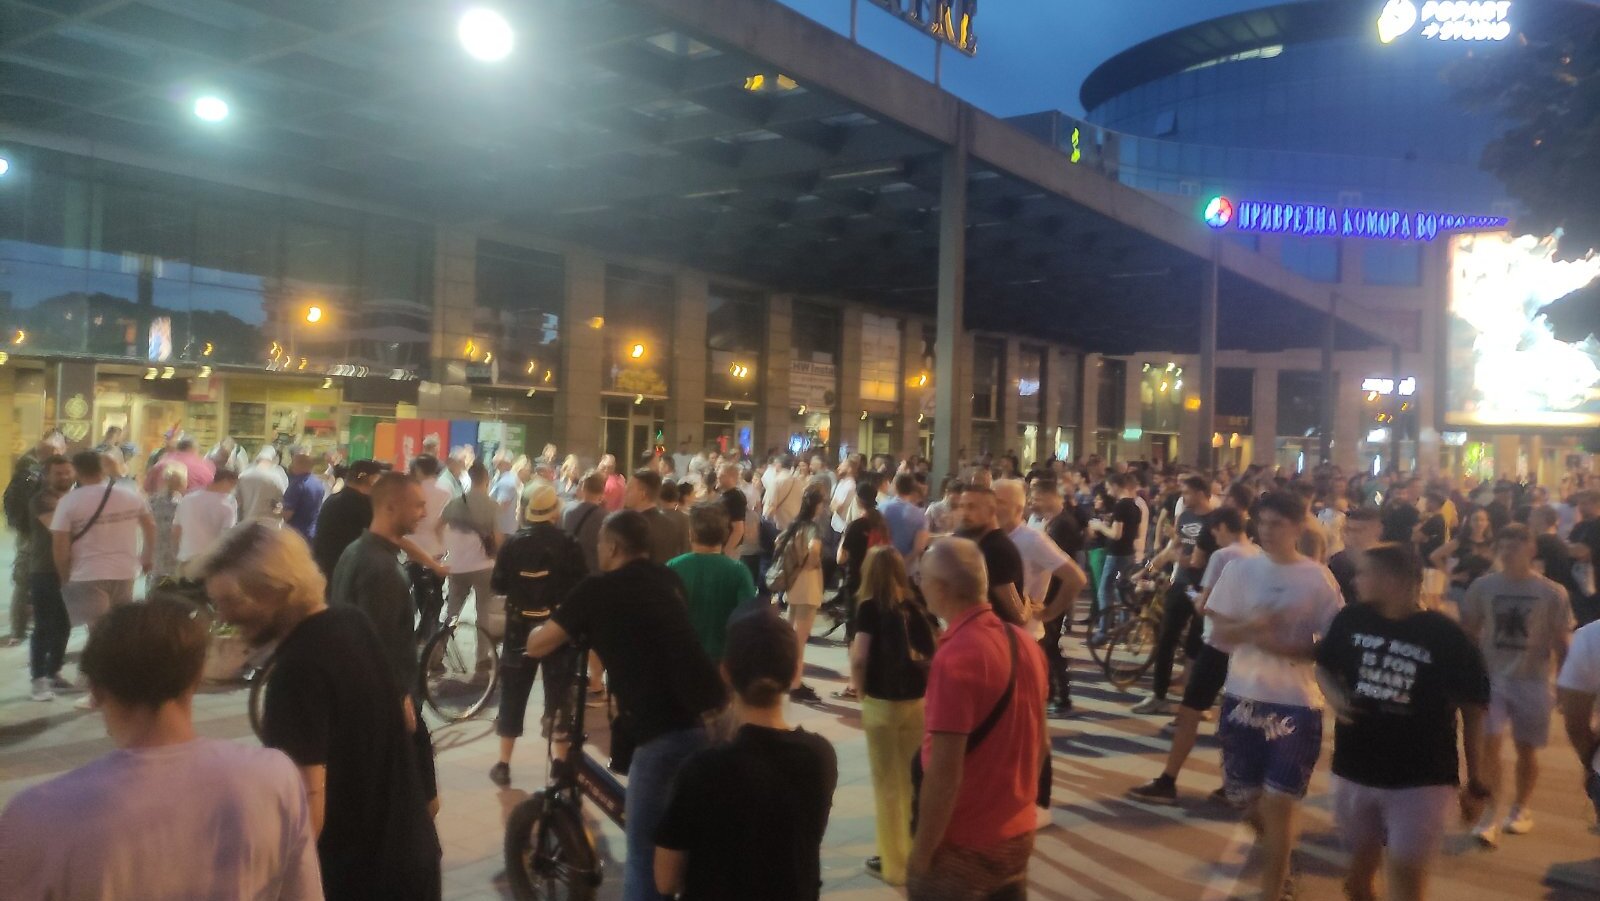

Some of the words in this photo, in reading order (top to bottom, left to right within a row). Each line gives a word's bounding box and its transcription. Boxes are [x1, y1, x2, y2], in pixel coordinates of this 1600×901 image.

[1238, 201, 1337, 236] ПРИВРЕДНА
[1342, 207, 1411, 240] КОМОРА
[1352, 632, 1385, 649] TOP
